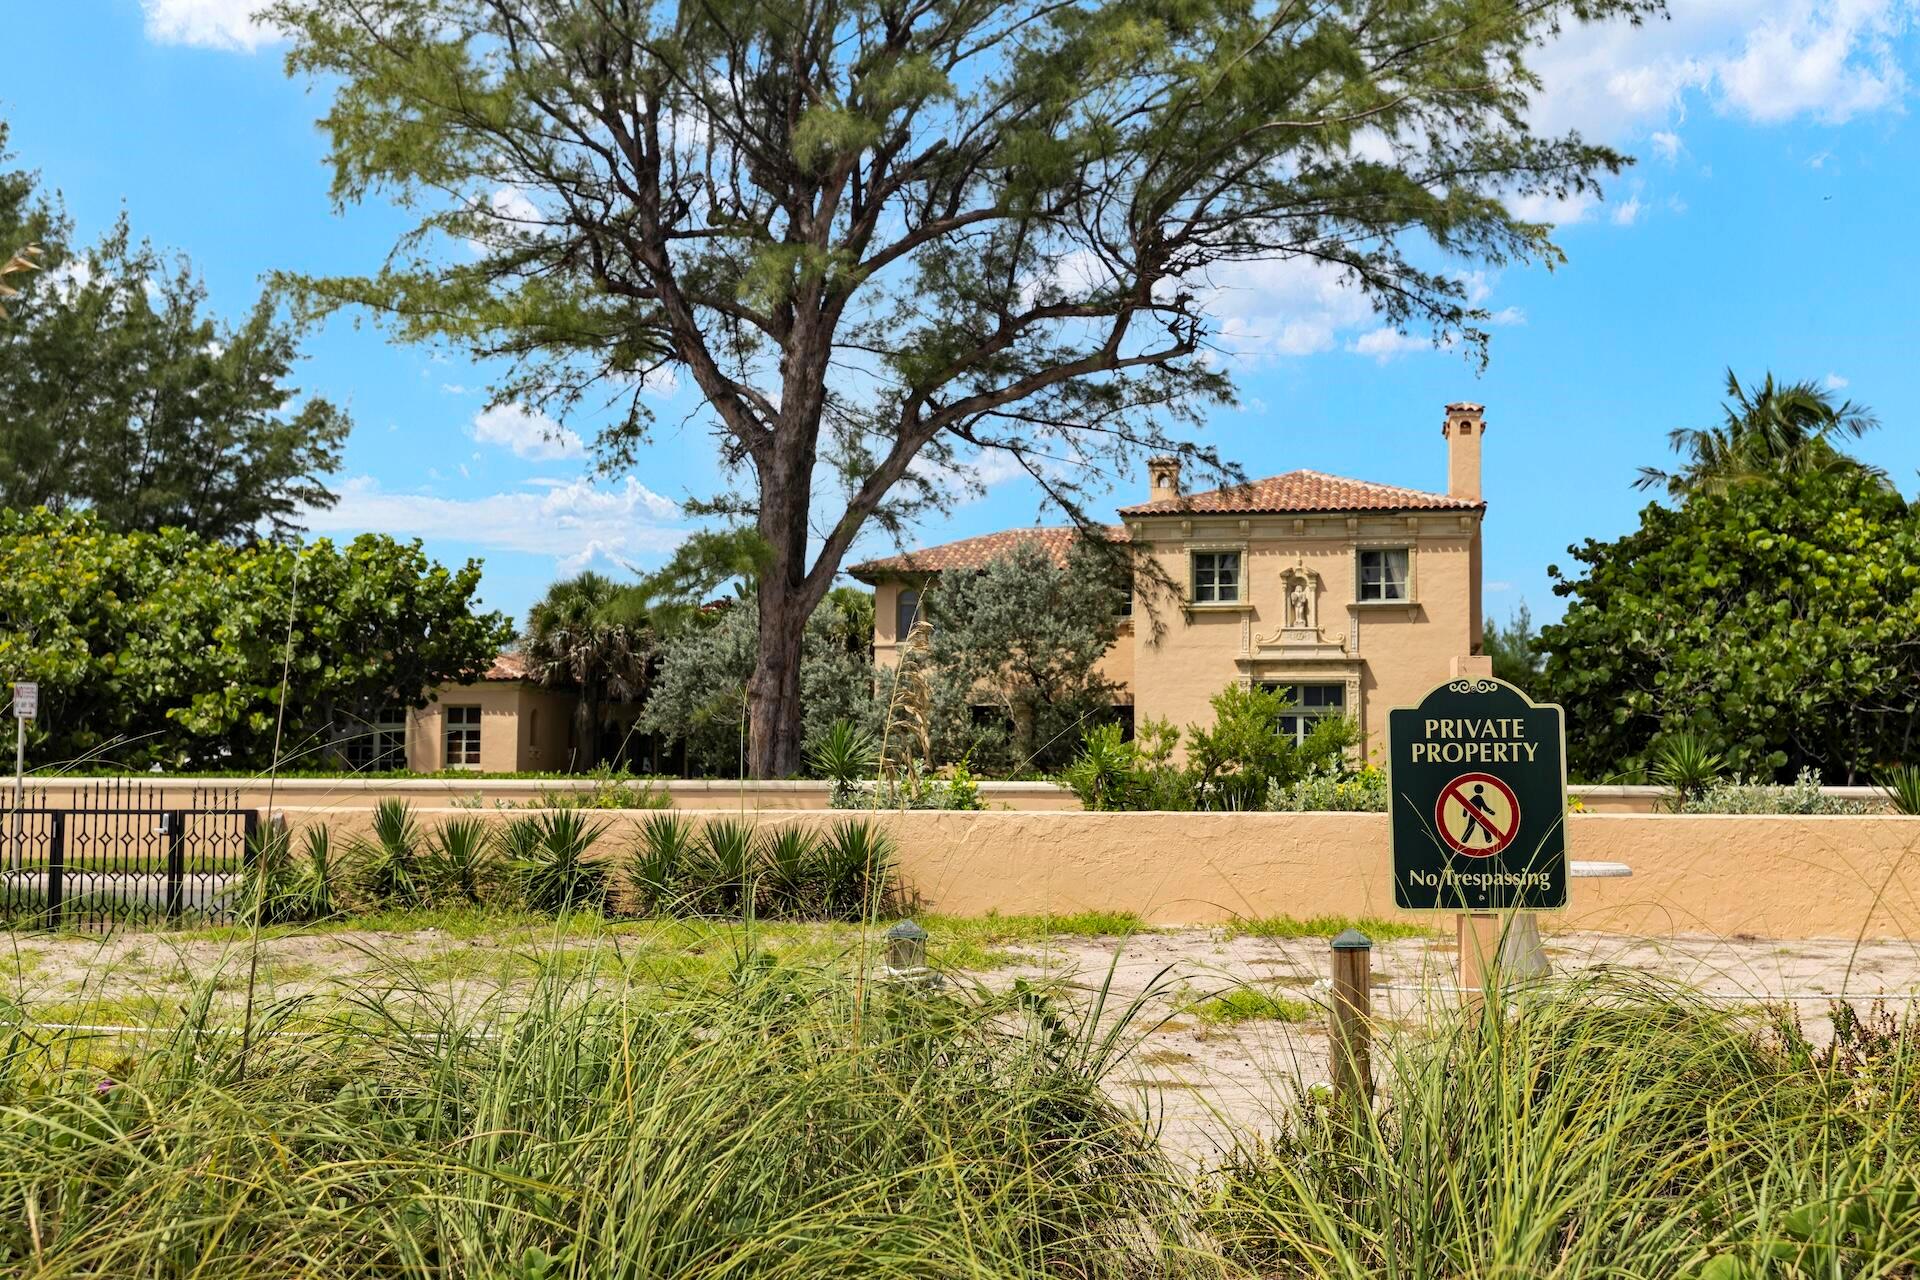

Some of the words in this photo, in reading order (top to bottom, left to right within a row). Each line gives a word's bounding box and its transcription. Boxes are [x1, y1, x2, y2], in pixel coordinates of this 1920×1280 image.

[1425, 719, 1525, 739] PRIVATE
[1411, 742, 1539, 762] PROPERTY
[1409, 869, 1438, 886] No
[1443, 867, 1551, 891] Trespassing
